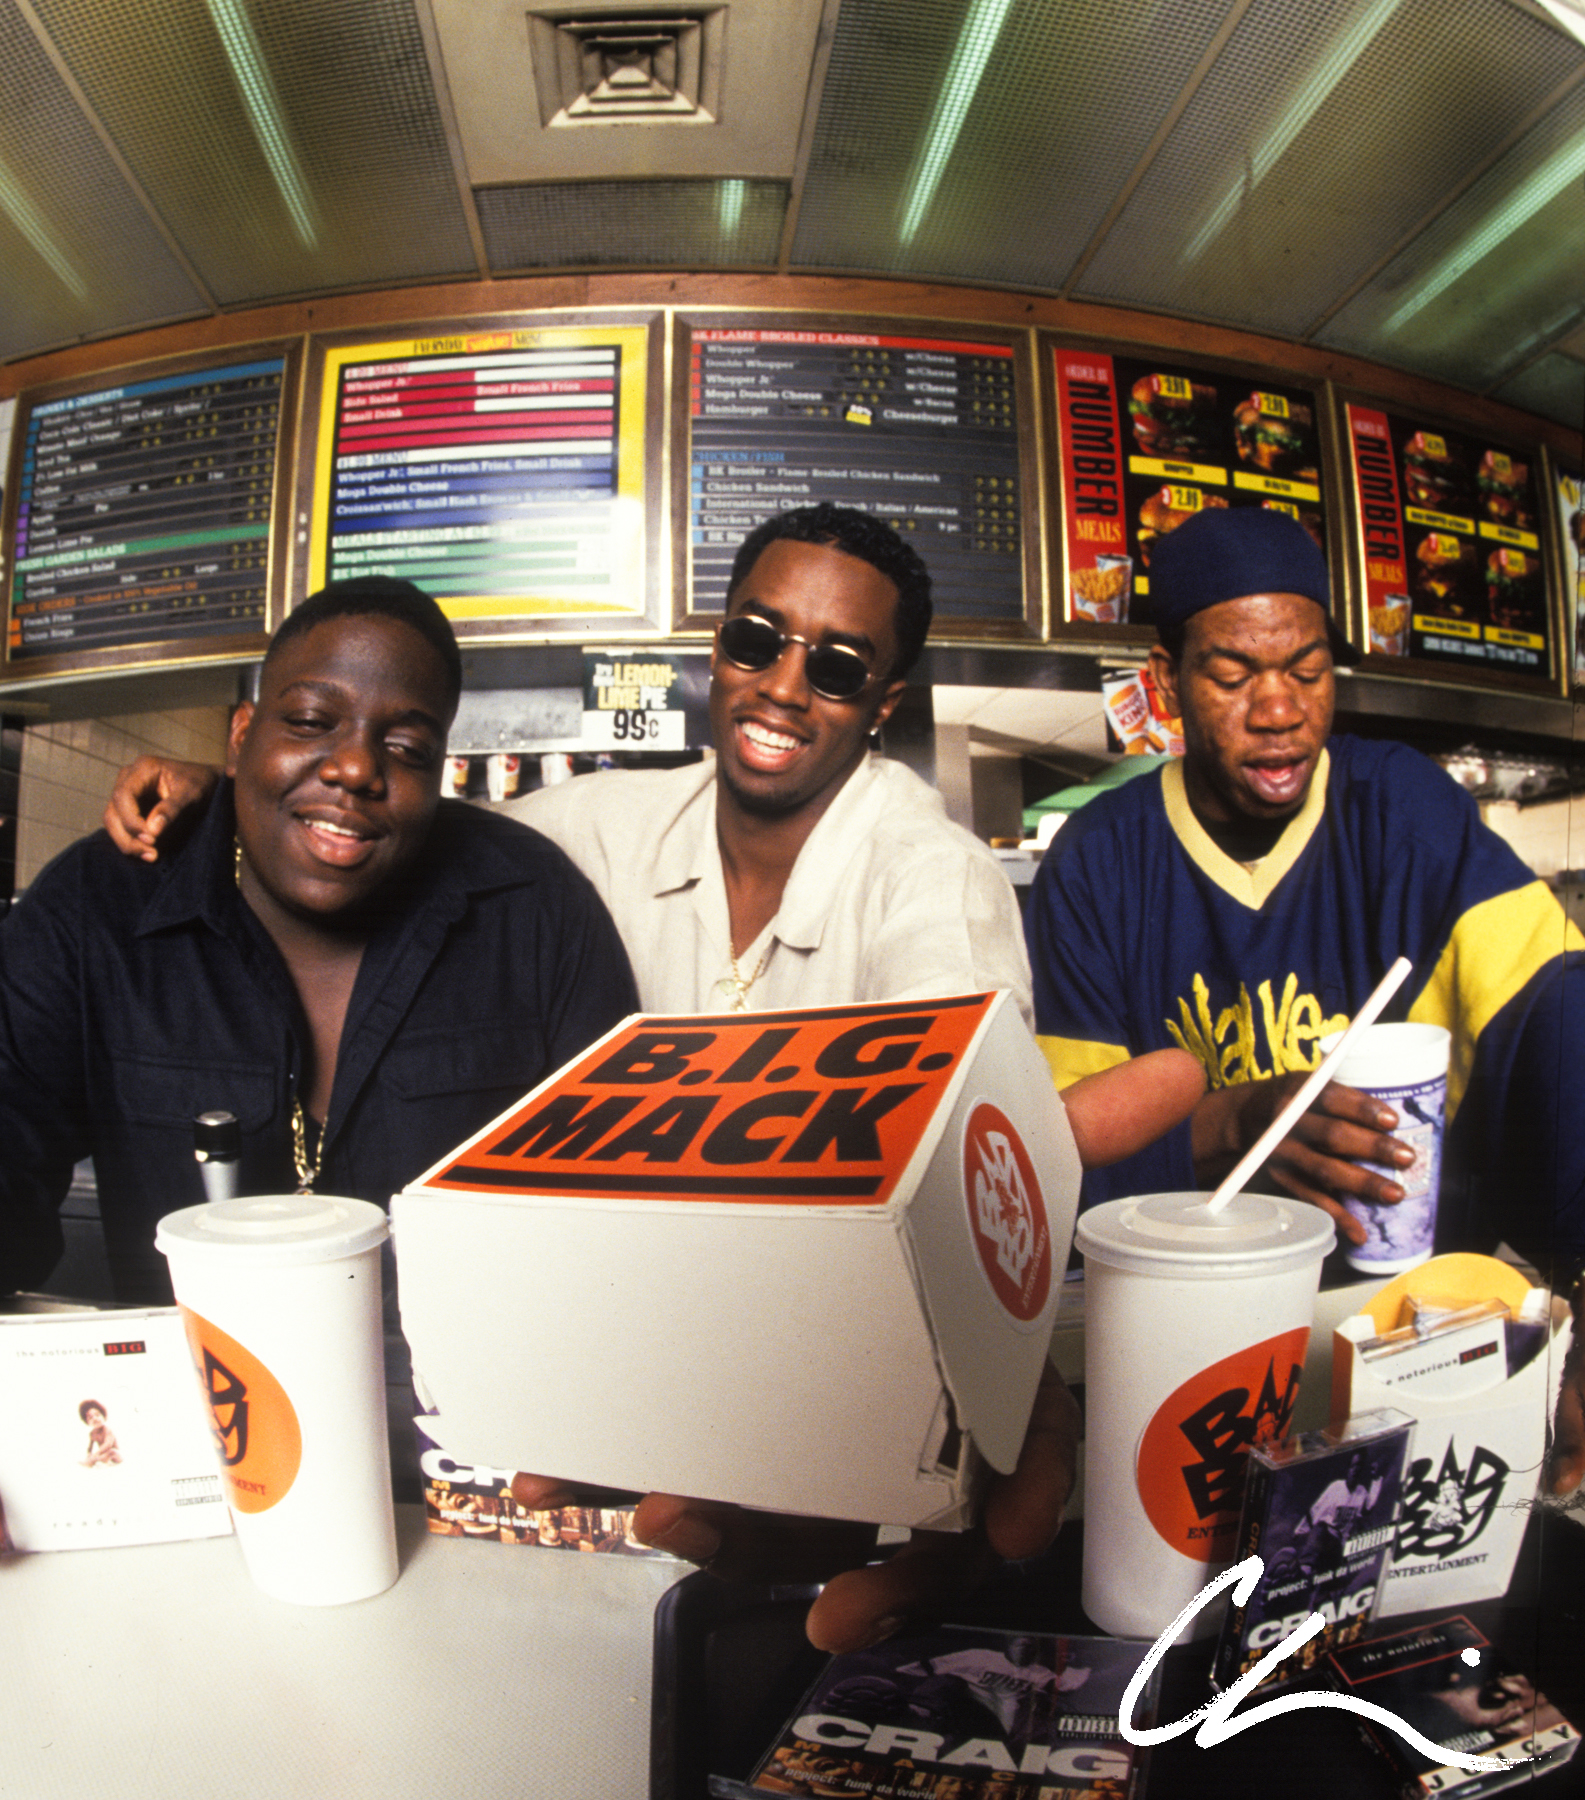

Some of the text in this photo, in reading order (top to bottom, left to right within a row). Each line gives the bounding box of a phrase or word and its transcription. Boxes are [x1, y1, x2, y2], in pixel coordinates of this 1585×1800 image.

[708, 330, 757, 342] FLAME
[760, 331, 817, 345] BROILED
[818, 333, 880, 346] CLASSICS
[345, 380, 393, 393] Whopper
[705, 374, 756, 386] Whopper
[477, 382, 581, 397] Small French Fries
[739, 389, 780, 400] Double
[781, 389, 823, 401] Cheese
[368, 393, 400, 406] Salad
[343, 408, 404, 424] Small Drink
[705, 403, 769, 417] Hamburger
[882, 409, 959, 425] Cheeseburger
[1067, 379, 1119, 518] NUMBER
[338, 471, 387, 483] Whopper
[407, 464, 439, 477] Small
[440, 462, 480, 475] French
[514, 459, 549, 471] Small
[549, 457, 583, 469] Drink
[849, 469, 891, 481] Chicken
[892, 472, 941, 483] Sandwich
[367, 484, 408, 496] Double
[408, 481, 450, 493] Cheese
[706, 481, 810, 493] Chicken Sandwich
[415, 496, 449, 509] Small
[1356, 434, 1401, 561] NUMBER
[706, 497, 779, 510] International
[913, 504, 959, 517] American
[703, 514, 753, 526] Chicken
[1075, 518, 1122, 544] MEALS
[580, 1015, 955, 1085] B.I.G.
[484, 1081, 929, 1166] MACK
[105, 1342, 143, 1355] BIG
[1386, 1552, 1490, 1580] ENTERTAINMENT
[1247, 1586, 1376, 1650] CRAIG
[791, 1713, 1131, 1780] CRAIG
[784, 1767, 837, 1786] project:
[844, 1778, 874, 1793] funk
[876, 1784, 894, 1796] da
